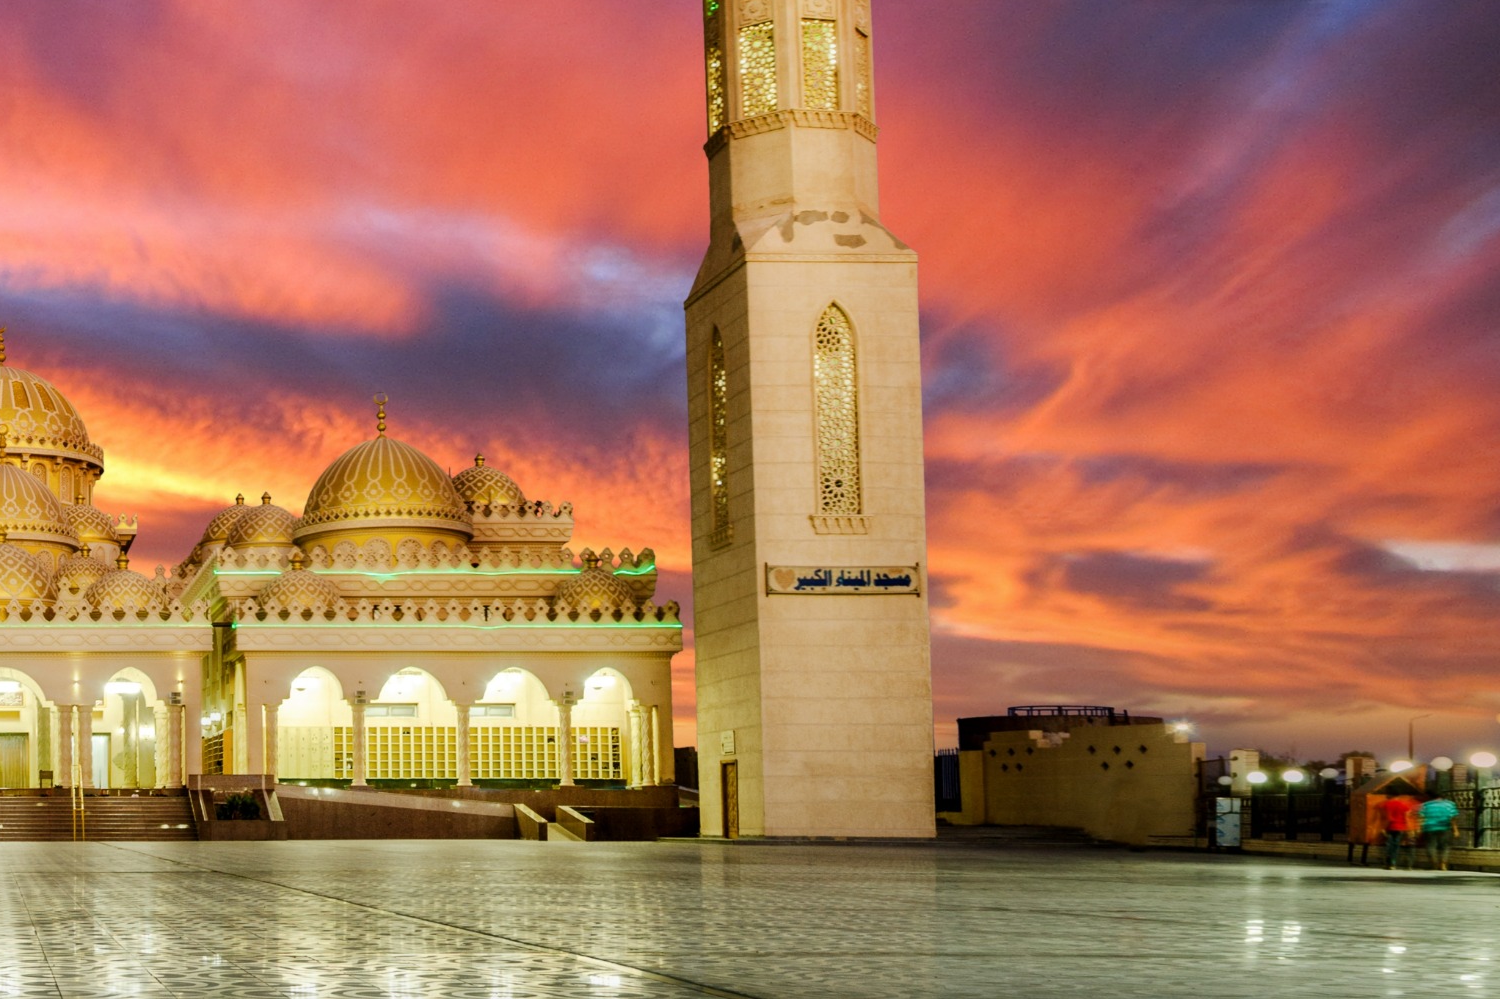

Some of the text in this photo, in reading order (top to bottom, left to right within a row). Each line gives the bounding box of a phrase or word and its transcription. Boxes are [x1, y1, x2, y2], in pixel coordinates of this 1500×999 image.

[794, 569, 911, 591] مسجد الميناء الكبير
